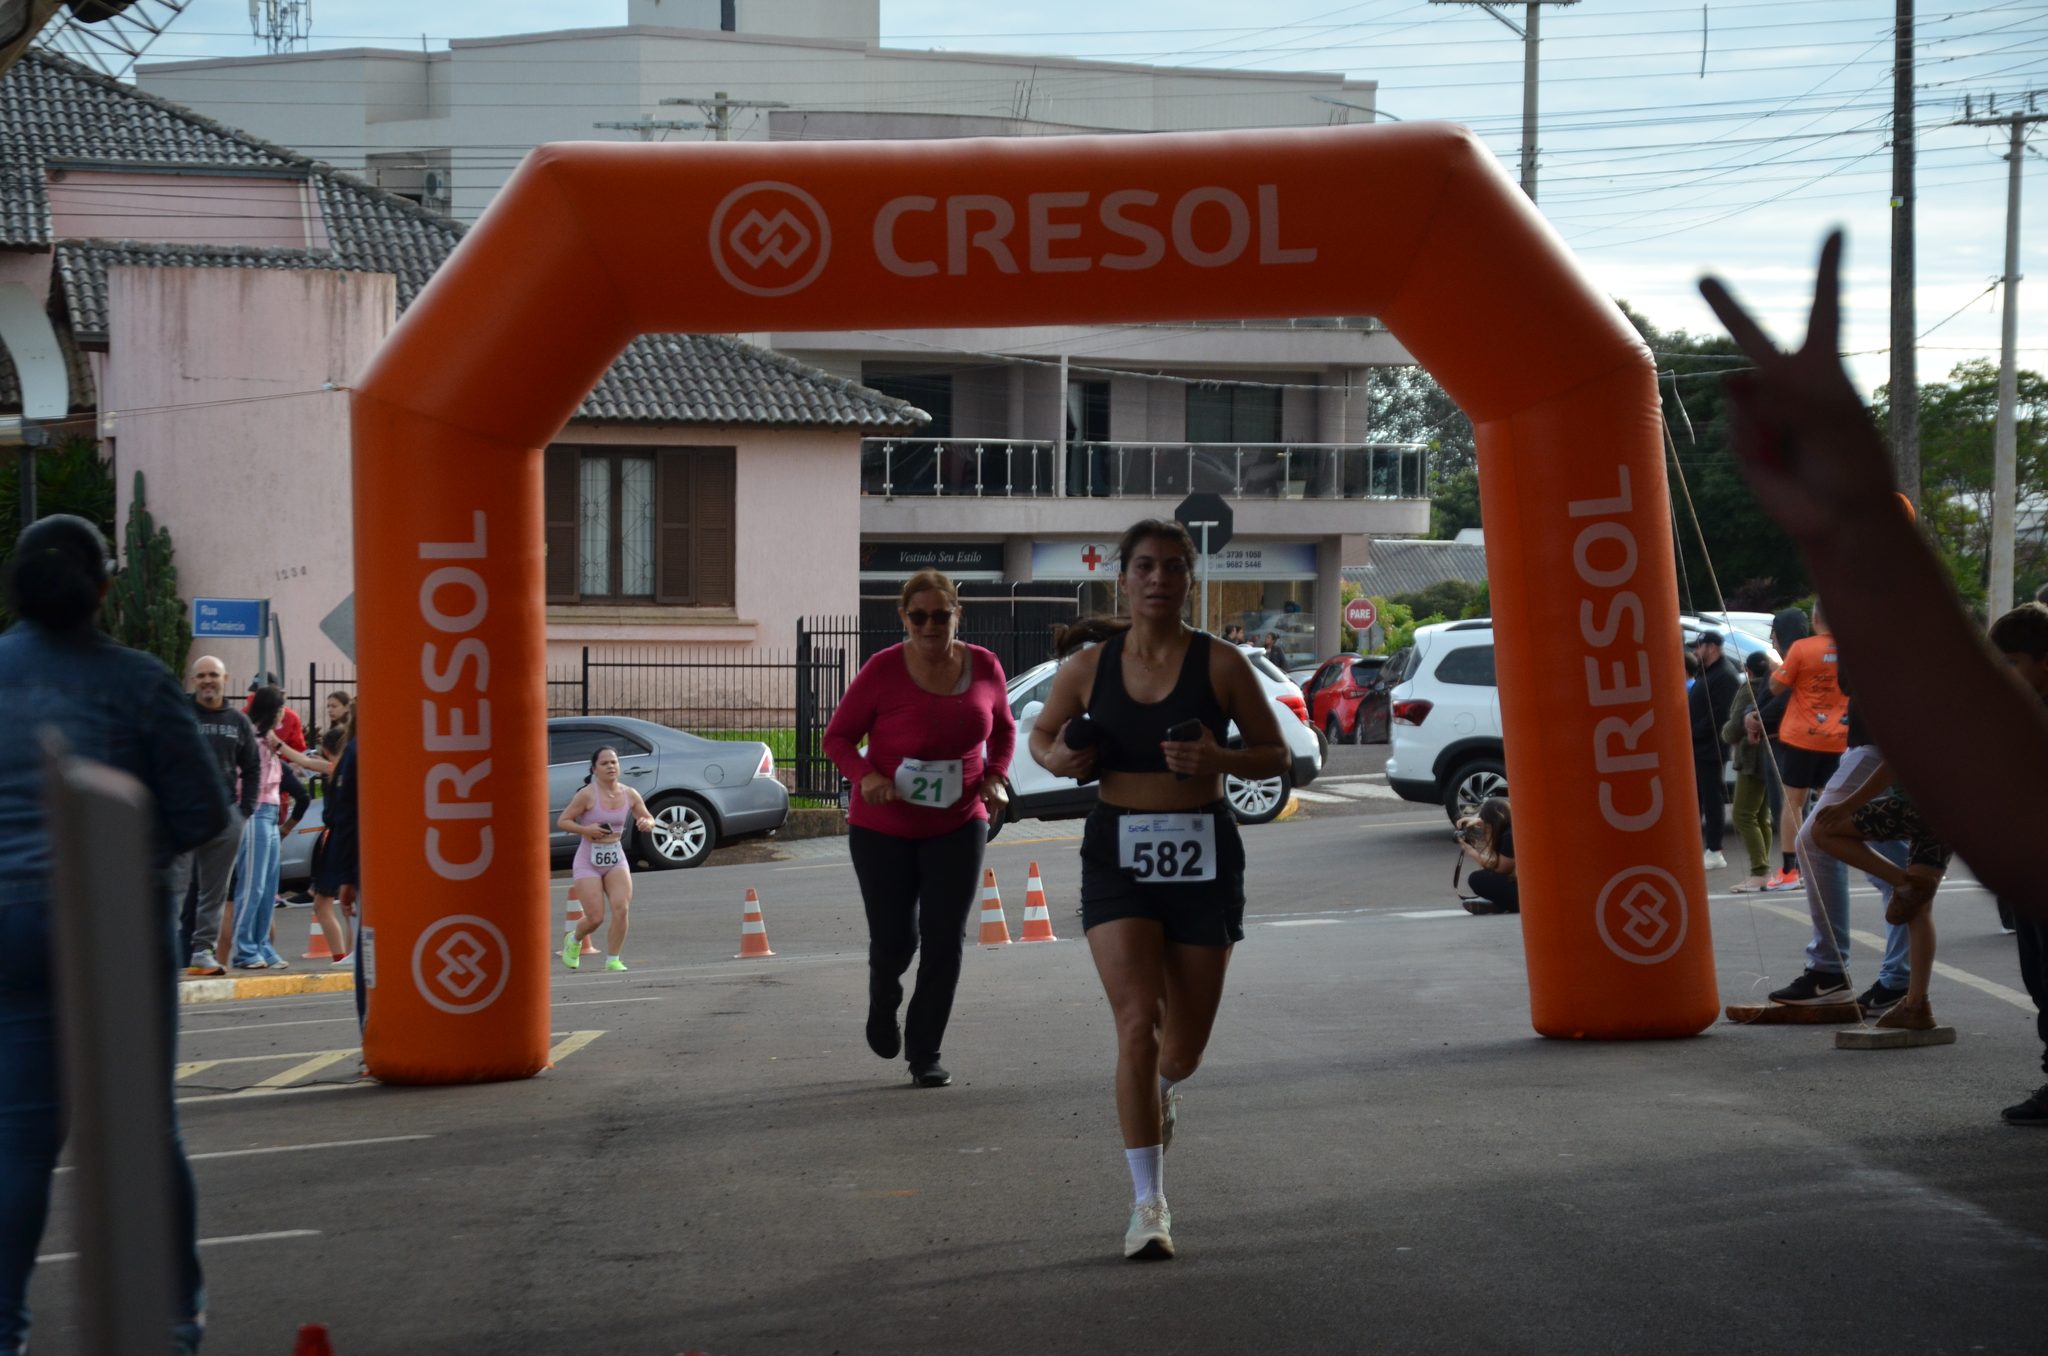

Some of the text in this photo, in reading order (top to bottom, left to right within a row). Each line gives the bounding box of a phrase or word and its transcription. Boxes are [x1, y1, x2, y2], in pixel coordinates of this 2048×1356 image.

[872, 184, 1318, 277] CRESOL
[900, 551, 982, 562] Vestindo Seu Estilo
[201, 604, 218, 616] Rua
[1350, 608, 1371, 619] PARE
[201, 620, 211, 631] do
[1568, 463, 1664, 833] CRESOL
[418, 509, 495, 881] CRESOL
[911, 776, 943, 803] 21
[595, 851, 619, 865] 663
[1133, 840, 1203, 879] 582
